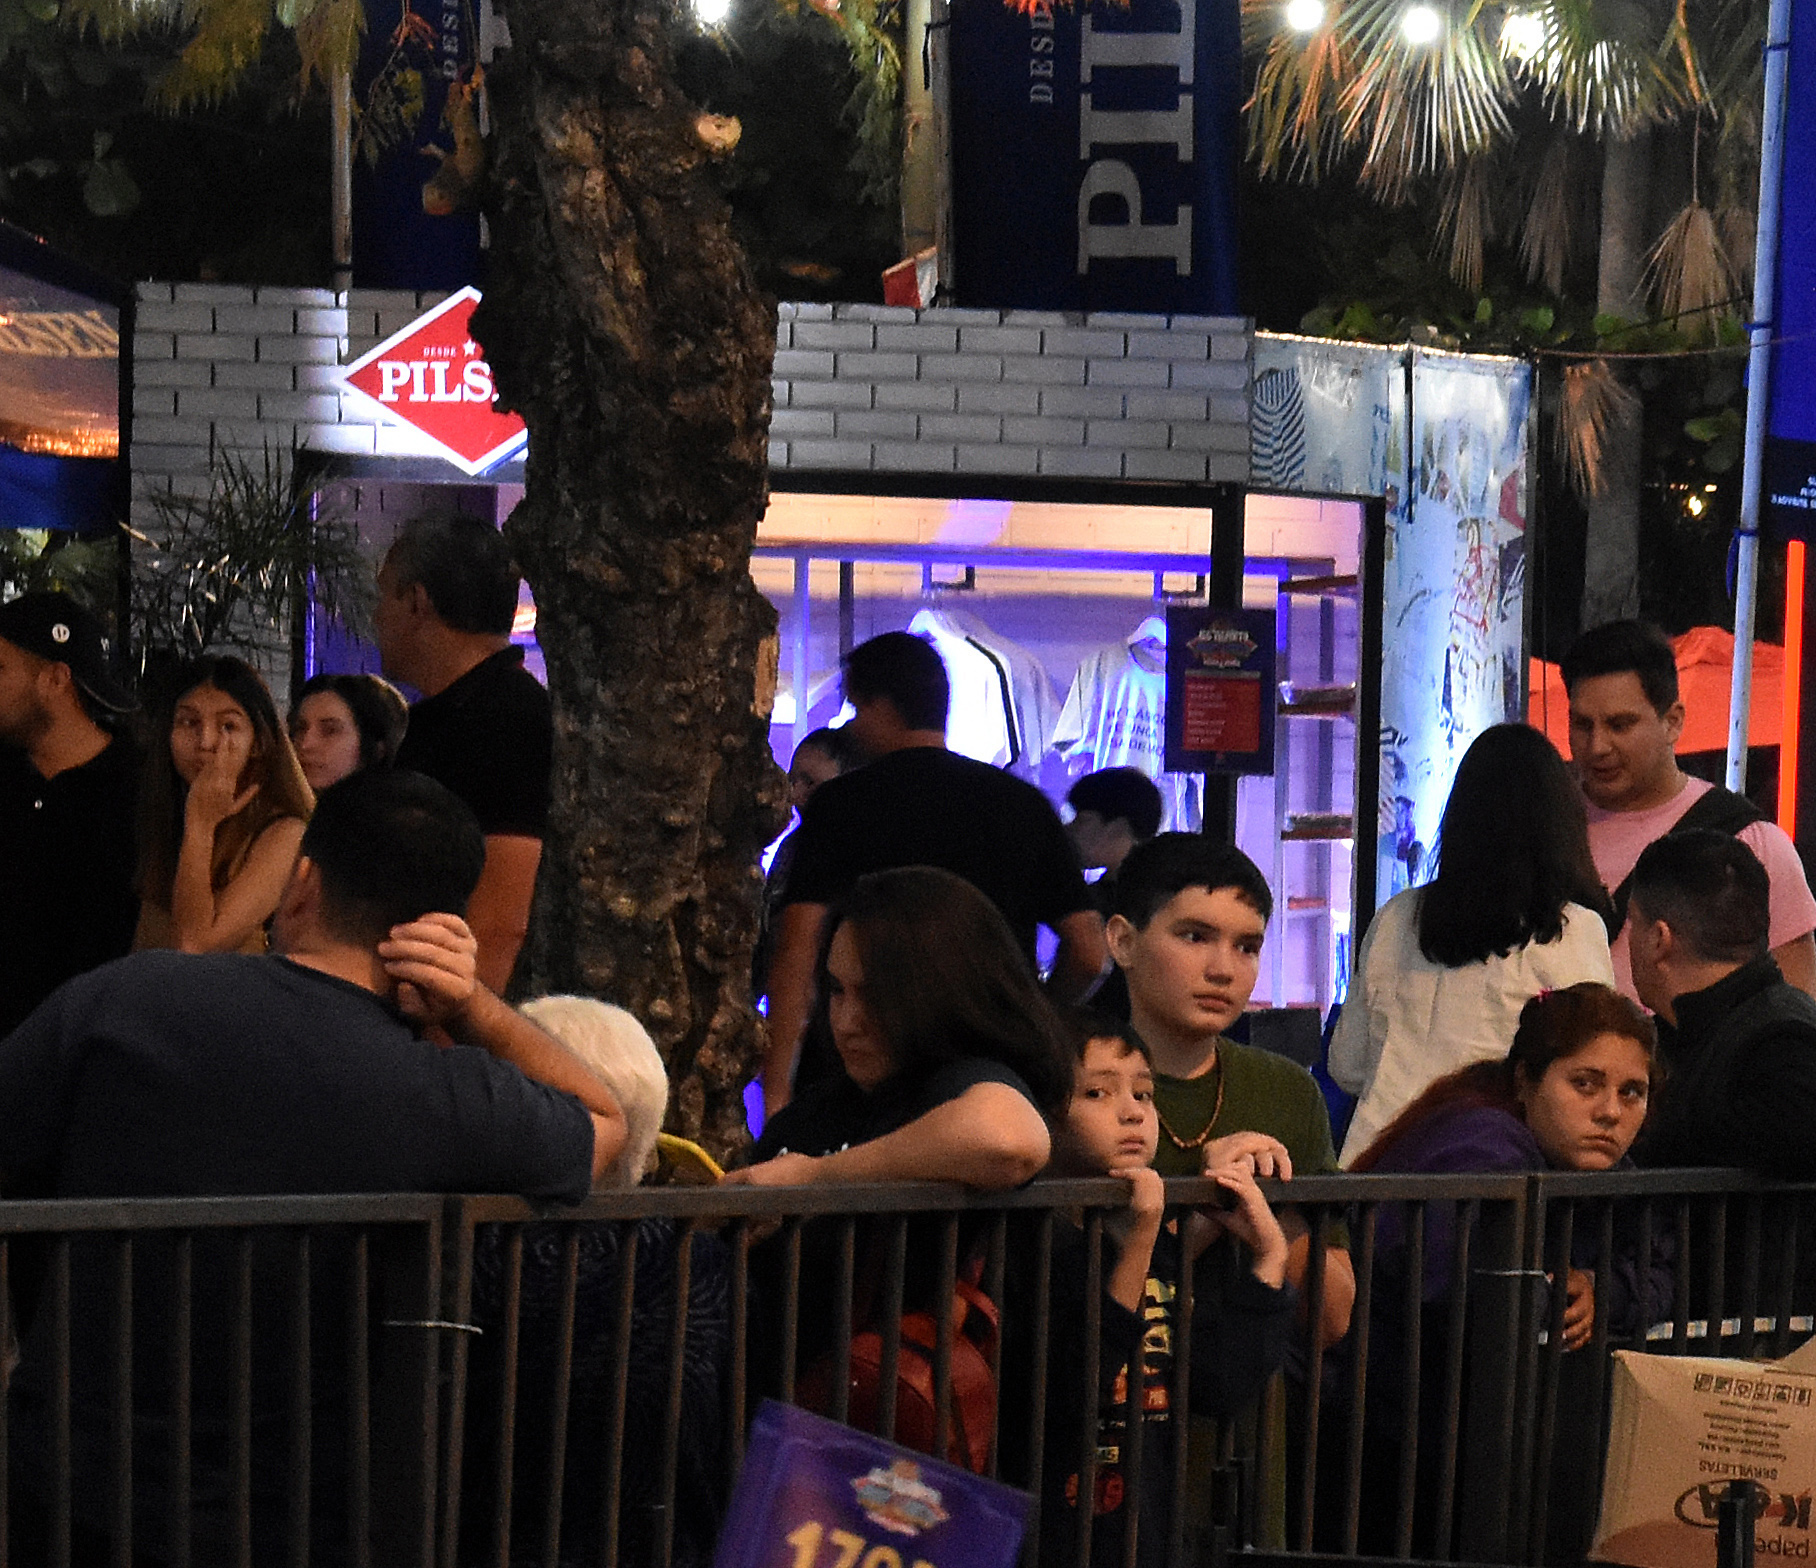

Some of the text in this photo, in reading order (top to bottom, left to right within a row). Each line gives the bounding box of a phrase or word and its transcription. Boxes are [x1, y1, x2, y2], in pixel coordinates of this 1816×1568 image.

[442, 0, 459, 77] DES
[423, 346, 457, 357] DESDE
[378, 360, 500, 403] PILS
[1698, 1460, 1779, 1481] SERVILLETAS
